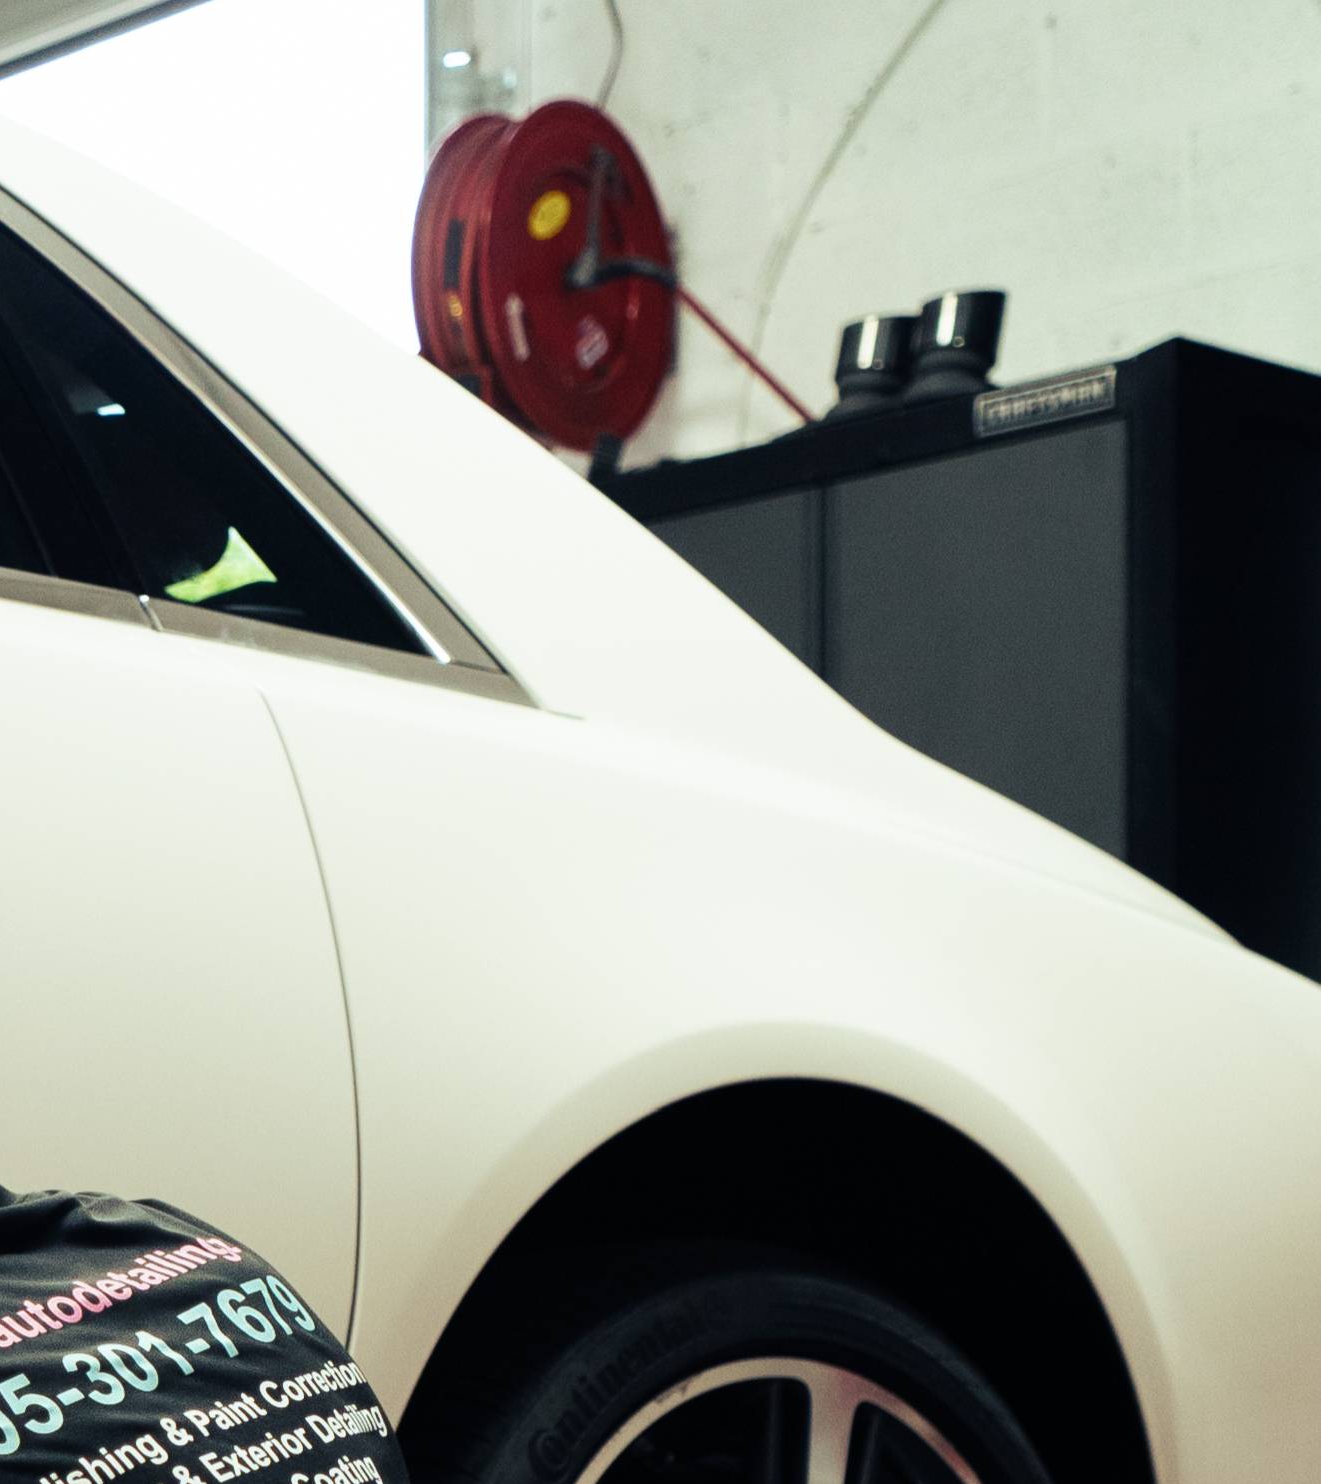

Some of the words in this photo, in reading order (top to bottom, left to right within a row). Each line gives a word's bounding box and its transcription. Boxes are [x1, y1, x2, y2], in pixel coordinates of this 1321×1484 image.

[159, 1417, 191, 1447] &
[183, 1393, 264, 1438] Paint
[259, 1360, 367, 1409] Correction
[199, 1428, 314, 1481] Exterior
[305, 1403, 388, 1444] Detailing
